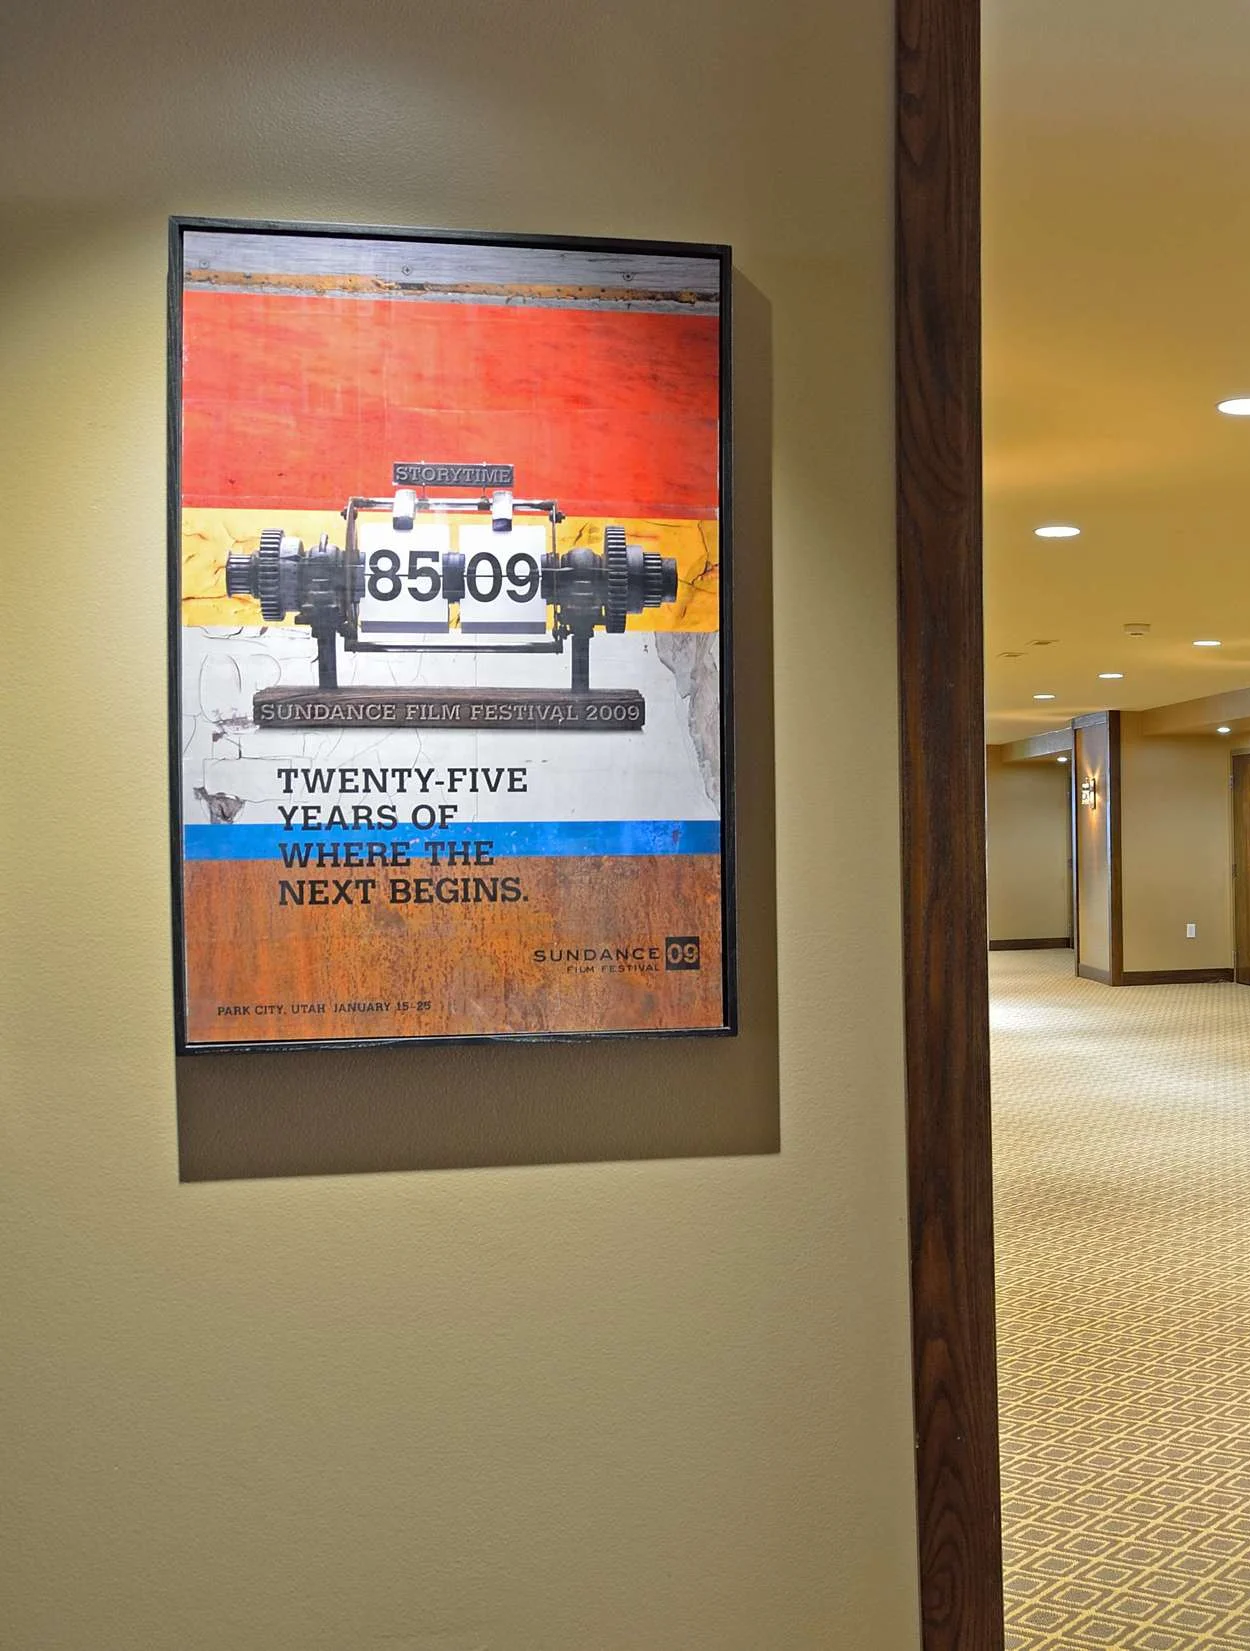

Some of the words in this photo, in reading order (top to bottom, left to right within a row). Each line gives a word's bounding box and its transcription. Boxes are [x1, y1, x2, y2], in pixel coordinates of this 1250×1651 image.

[395, 466, 511, 484] STORYTIME
[368, 549, 441, 602] 85
[467, 551, 540, 603] 09
[260, 703, 396, 721] SUNDANCE
[404, 704, 461, 721] FILM
[469, 704, 579, 723] FESTIVAL
[585, 704, 641, 722] 2009
[277, 768, 528, 794] TWENTY-FIVE
[278, 805, 398, 831] YEARS
[411, 804, 458, 830] OF
[278, 841, 411, 868] WHERE
[424, 841, 494, 866] THE
[278, 879, 376, 906] NEXT
[389, 877, 529, 904] BEGINS.
[533, 947, 661, 963] SUNDANCE
[666, 943, 699, 964] 09
[566, 965, 595, 974] FILM
[601, 964, 661, 974] FESTIVAL
[217, 1006, 250, 1016] PARK
[291, 1004, 325, 1014] UTAH
[333, 1002, 391, 1012] JANUARY
